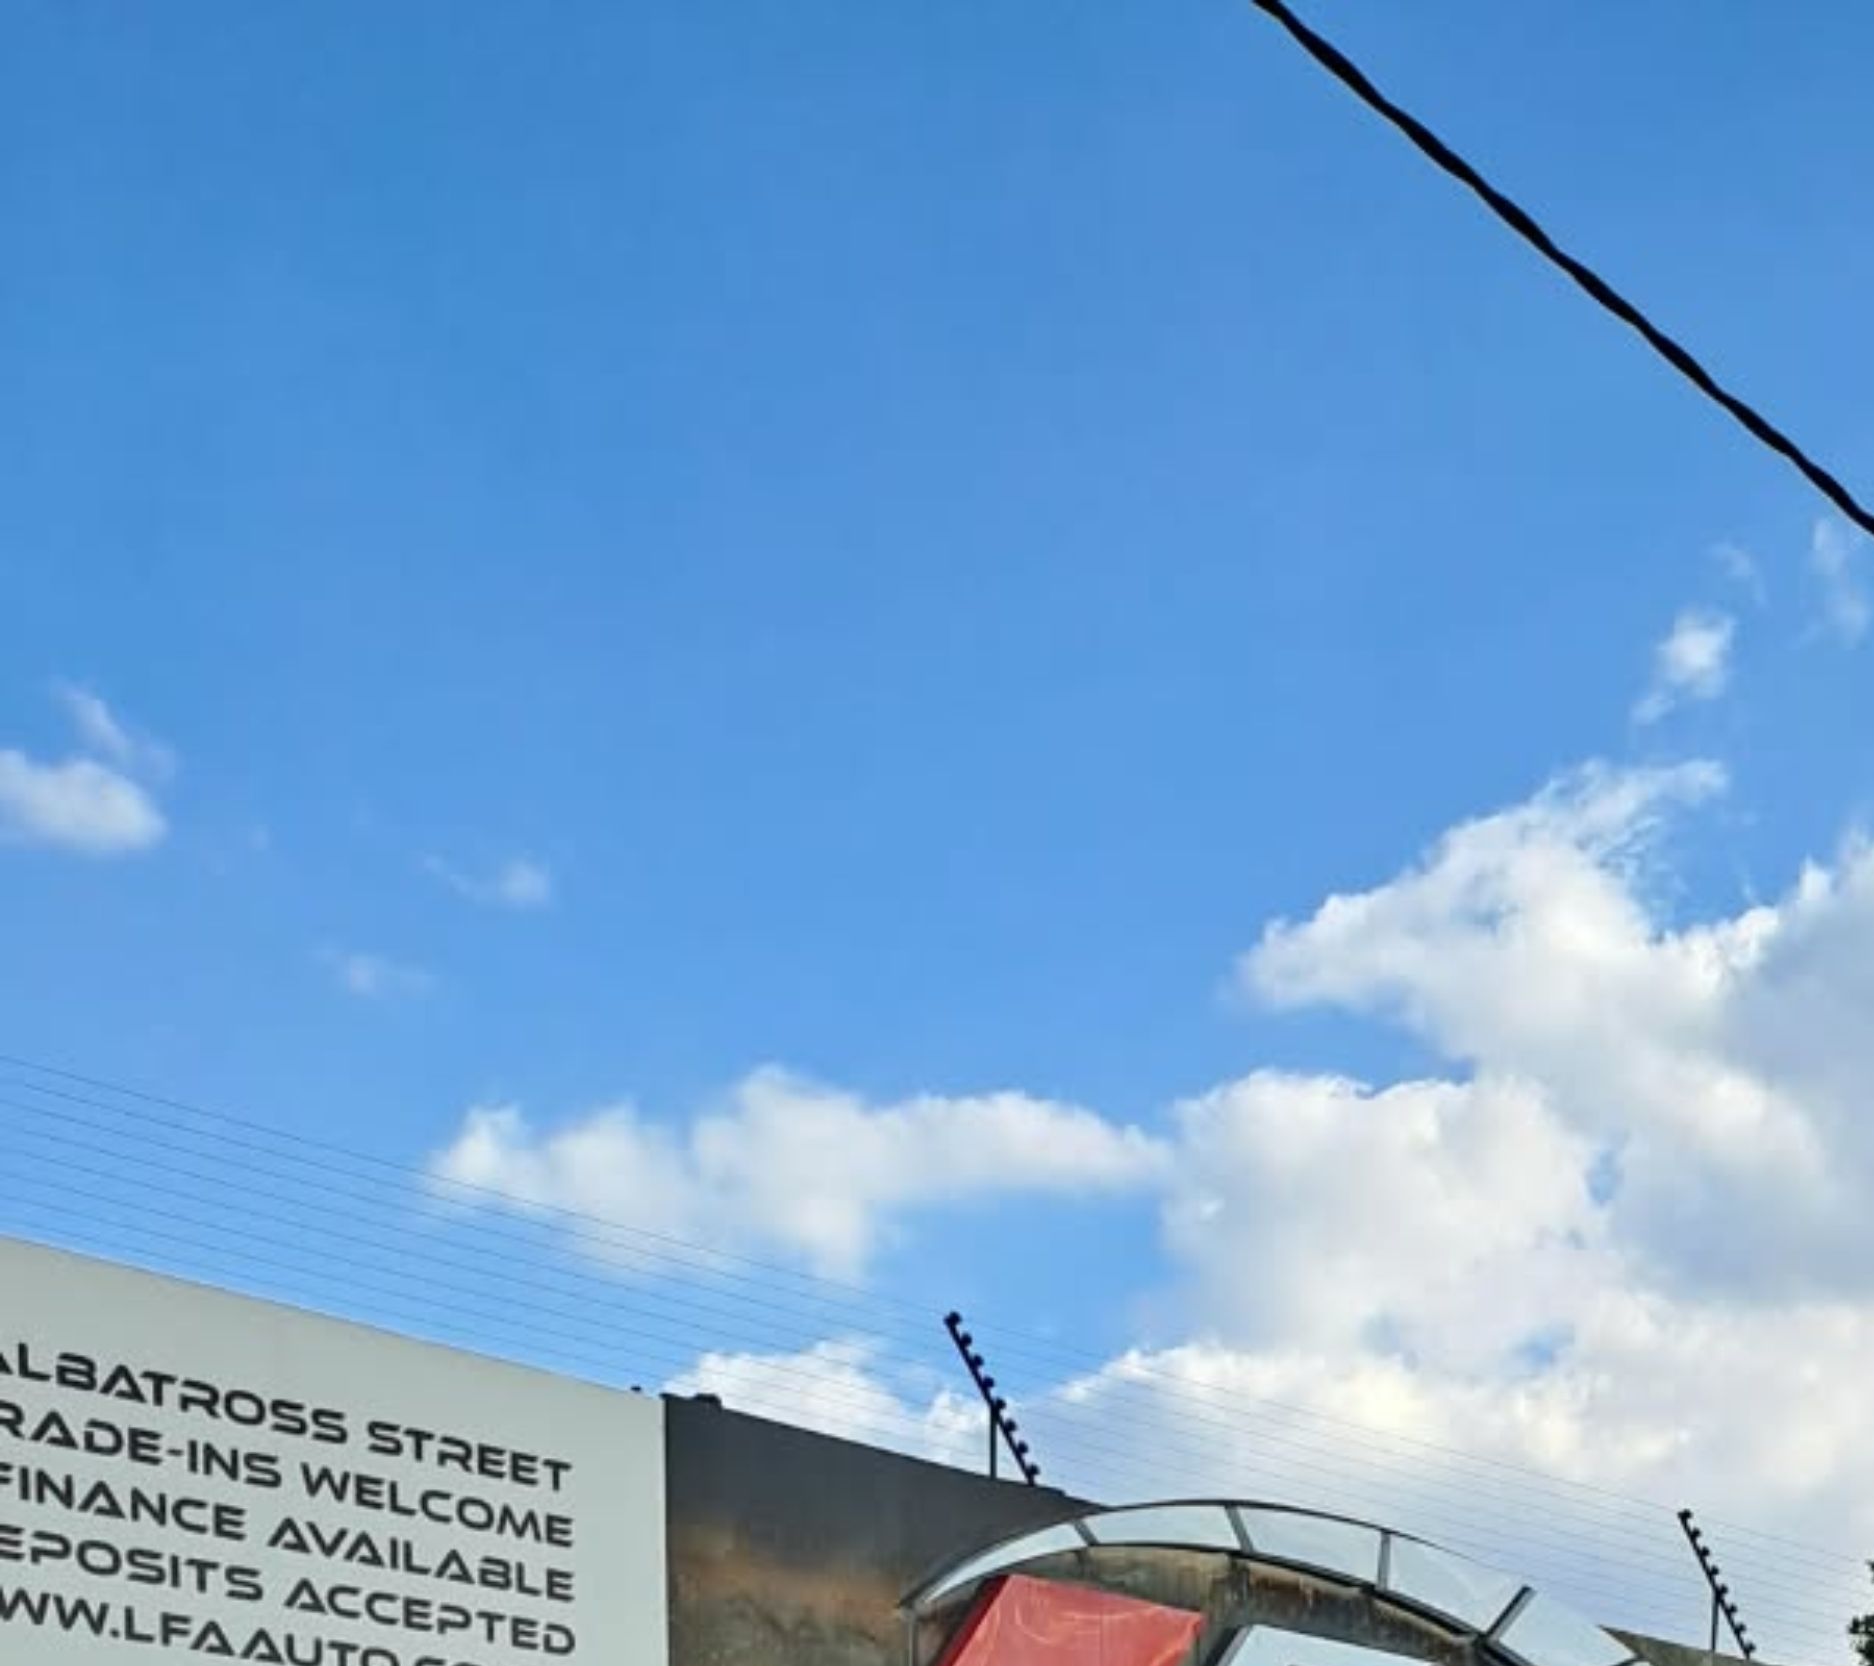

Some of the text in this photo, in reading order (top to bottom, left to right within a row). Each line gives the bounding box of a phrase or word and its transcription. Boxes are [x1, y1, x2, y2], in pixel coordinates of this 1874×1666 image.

[0, 1342, 573, 1492] LBATROSS STREET
[300, 1461, 573, 1548] WELCOME
[0, 1524, 576, 1656] EPOSITS ACCEPTED
[267, 1517, 574, 1603] AVAILABLE
